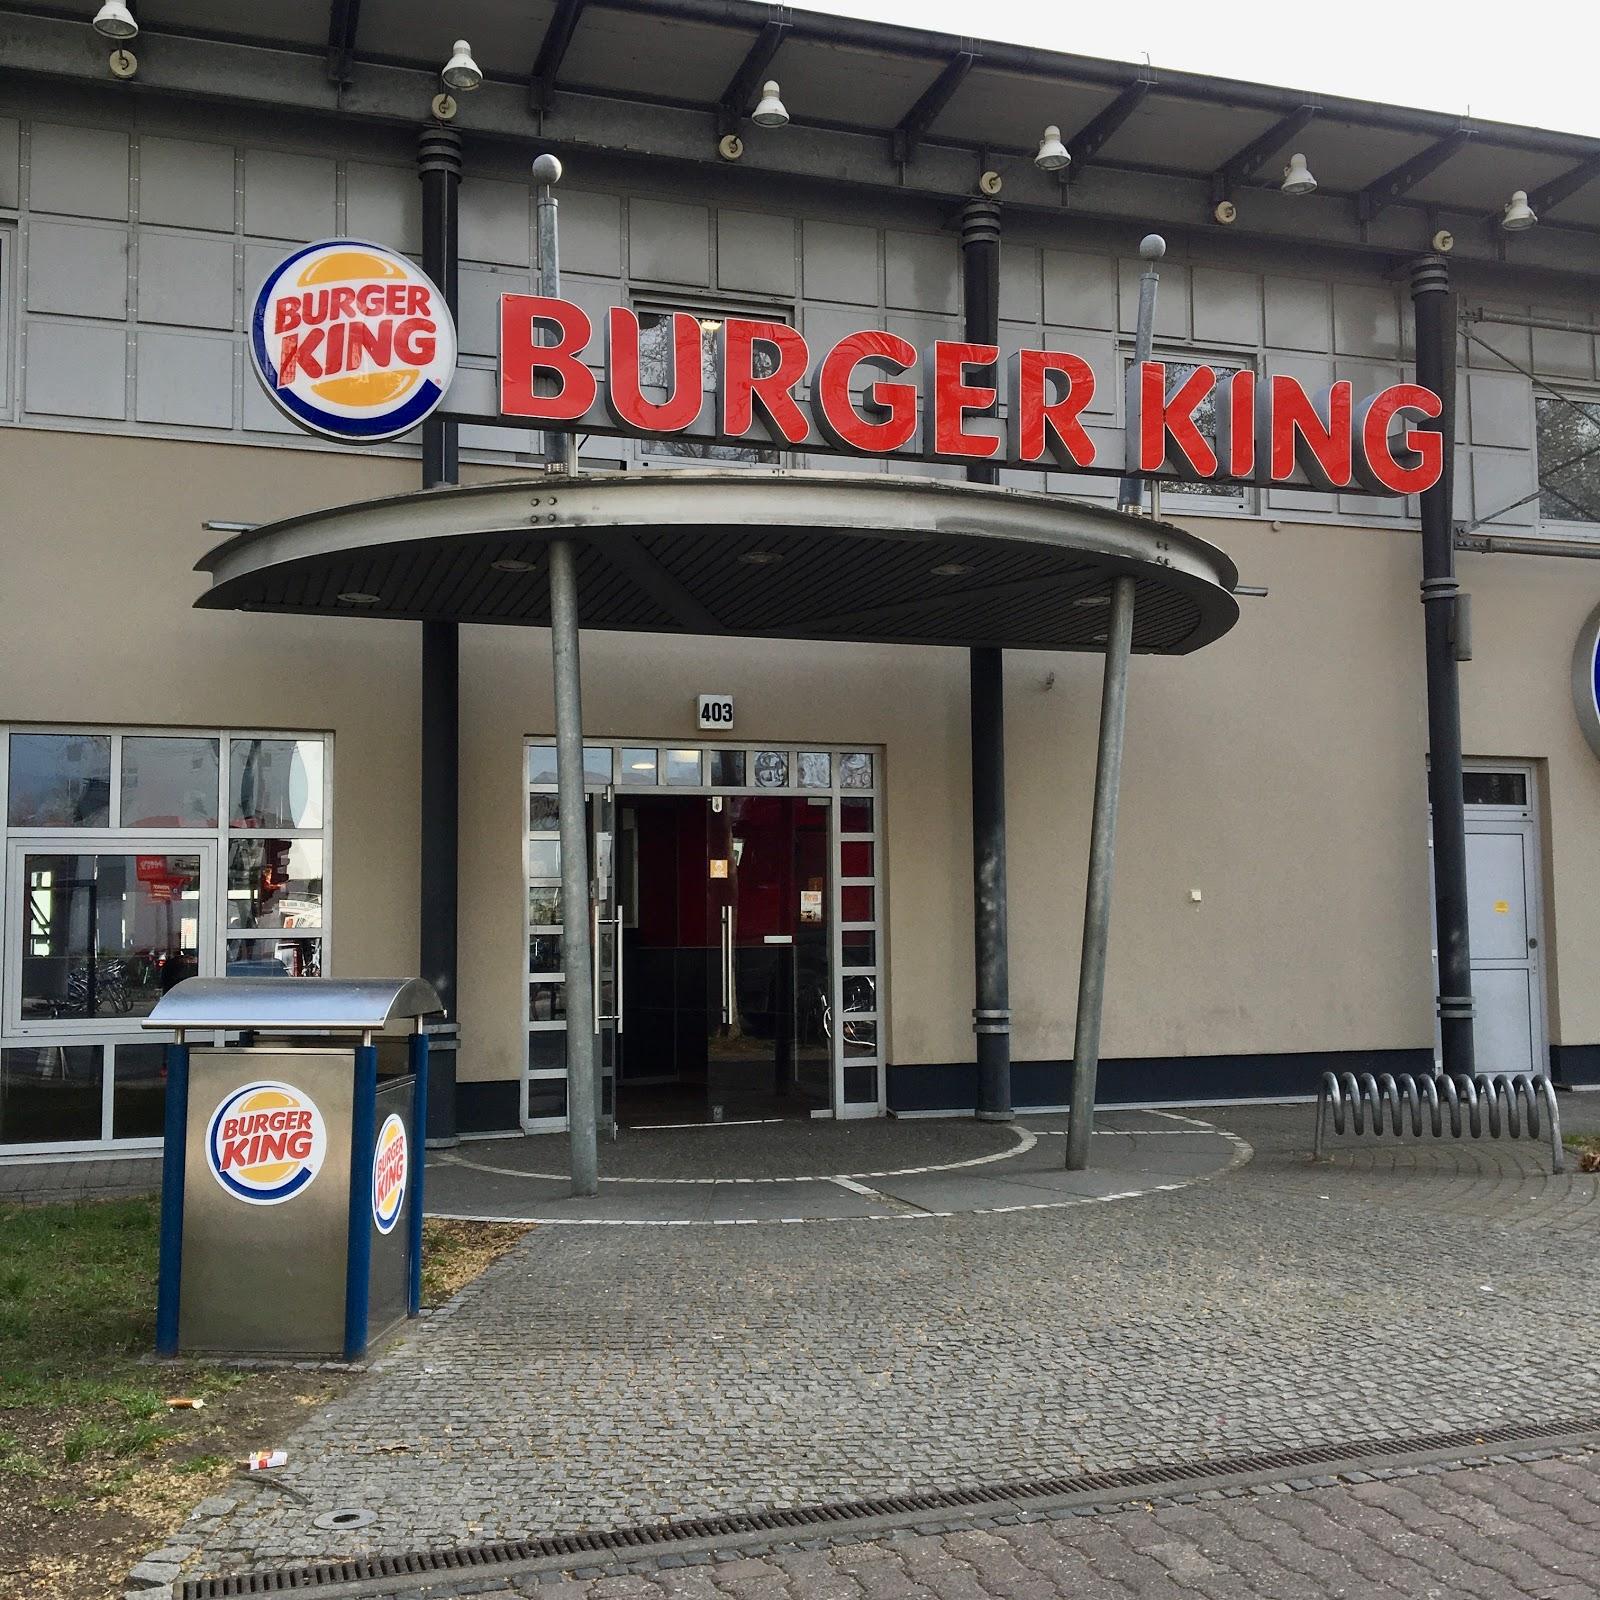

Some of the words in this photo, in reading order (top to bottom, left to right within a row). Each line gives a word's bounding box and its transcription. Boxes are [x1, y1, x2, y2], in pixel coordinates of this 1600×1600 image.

[274, 284, 431, 334] BURGER
[279, 317, 436, 386] KING
[499, 292, 1096, 468] BURGER
[1140, 362, 1443, 495] KING
[701, 702, 733, 722] 403
[222, 1111, 312, 1140] BURGER
[221, 1131, 313, 1170] KING
[378, 1136, 404, 1178] BURGER
[376, 1154, 404, 1208] KING
